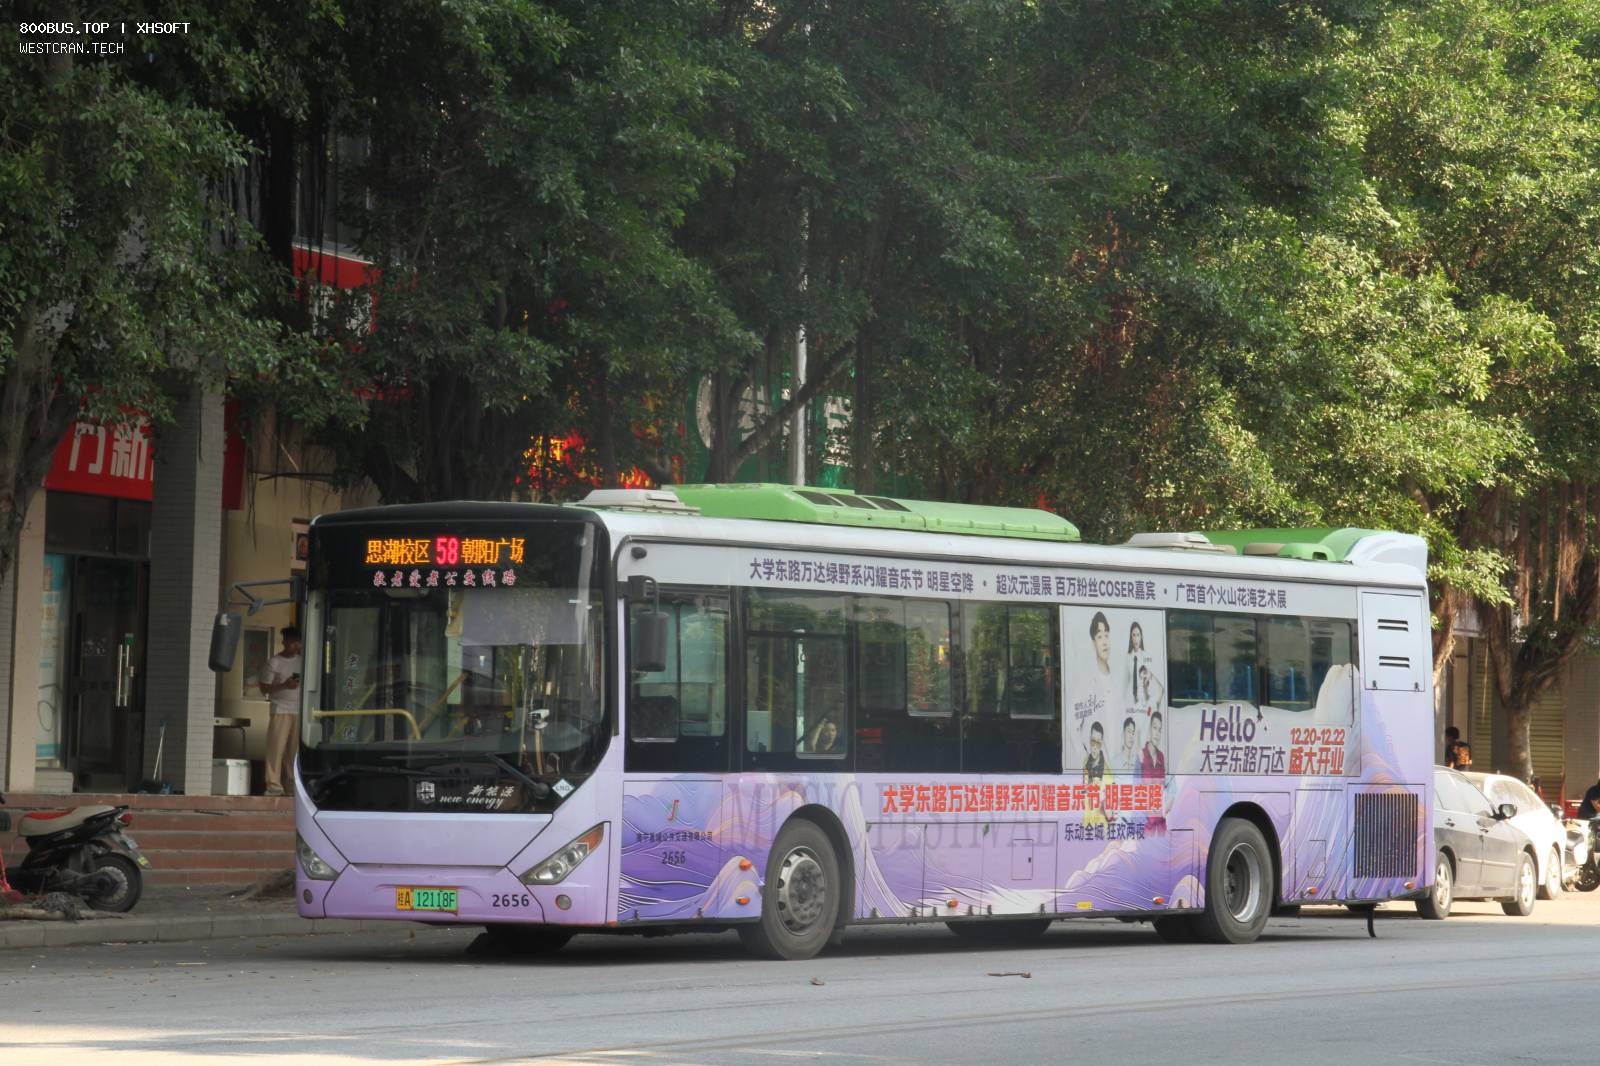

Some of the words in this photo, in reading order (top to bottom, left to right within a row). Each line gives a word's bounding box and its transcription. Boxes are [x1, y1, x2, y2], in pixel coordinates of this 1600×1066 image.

[67, 418, 154, 481] 门新
[366, 538, 431, 564] 思湖校区
[436, 537, 459, 564] 58
[461, 537, 526, 564] 朝阳广场
[750, 558, 923, 589] 大学东路万达绿野系闪耀音乐节
[927, 571, 974, 594] 明星空降
[996, 573, 1052, 597] 超次元漫展
[1055, 576, 1156, 601] 百万粉丝COSER嘉宾
[1175, 583, 1287, 609] 广西首个火山花海艺术展
[1200, 705, 1256, 742] Hello
[1290, 727, 1345, 745] 12.20-12.22
[1199, 745, 1286, 774] 大学东路万达
[1288, 747, 1345, 775] 盛大开业
[468, 784, 515, 797] 新能源
[882, 784, 1101, 813] 大学东路万达绿野系闪耀音乐节
[1104, 784, 1163, 812] 明星空降
[440, 795, 463, 803] new
[466, 796, 504, 810] energy
[1064, 824, 1104, 841] 乐动全城
[1106, 823, 1146, 841] 狂欢两夜
[661, 851, 686, 865] 2656
[492, 894, 530, 908] 2656
